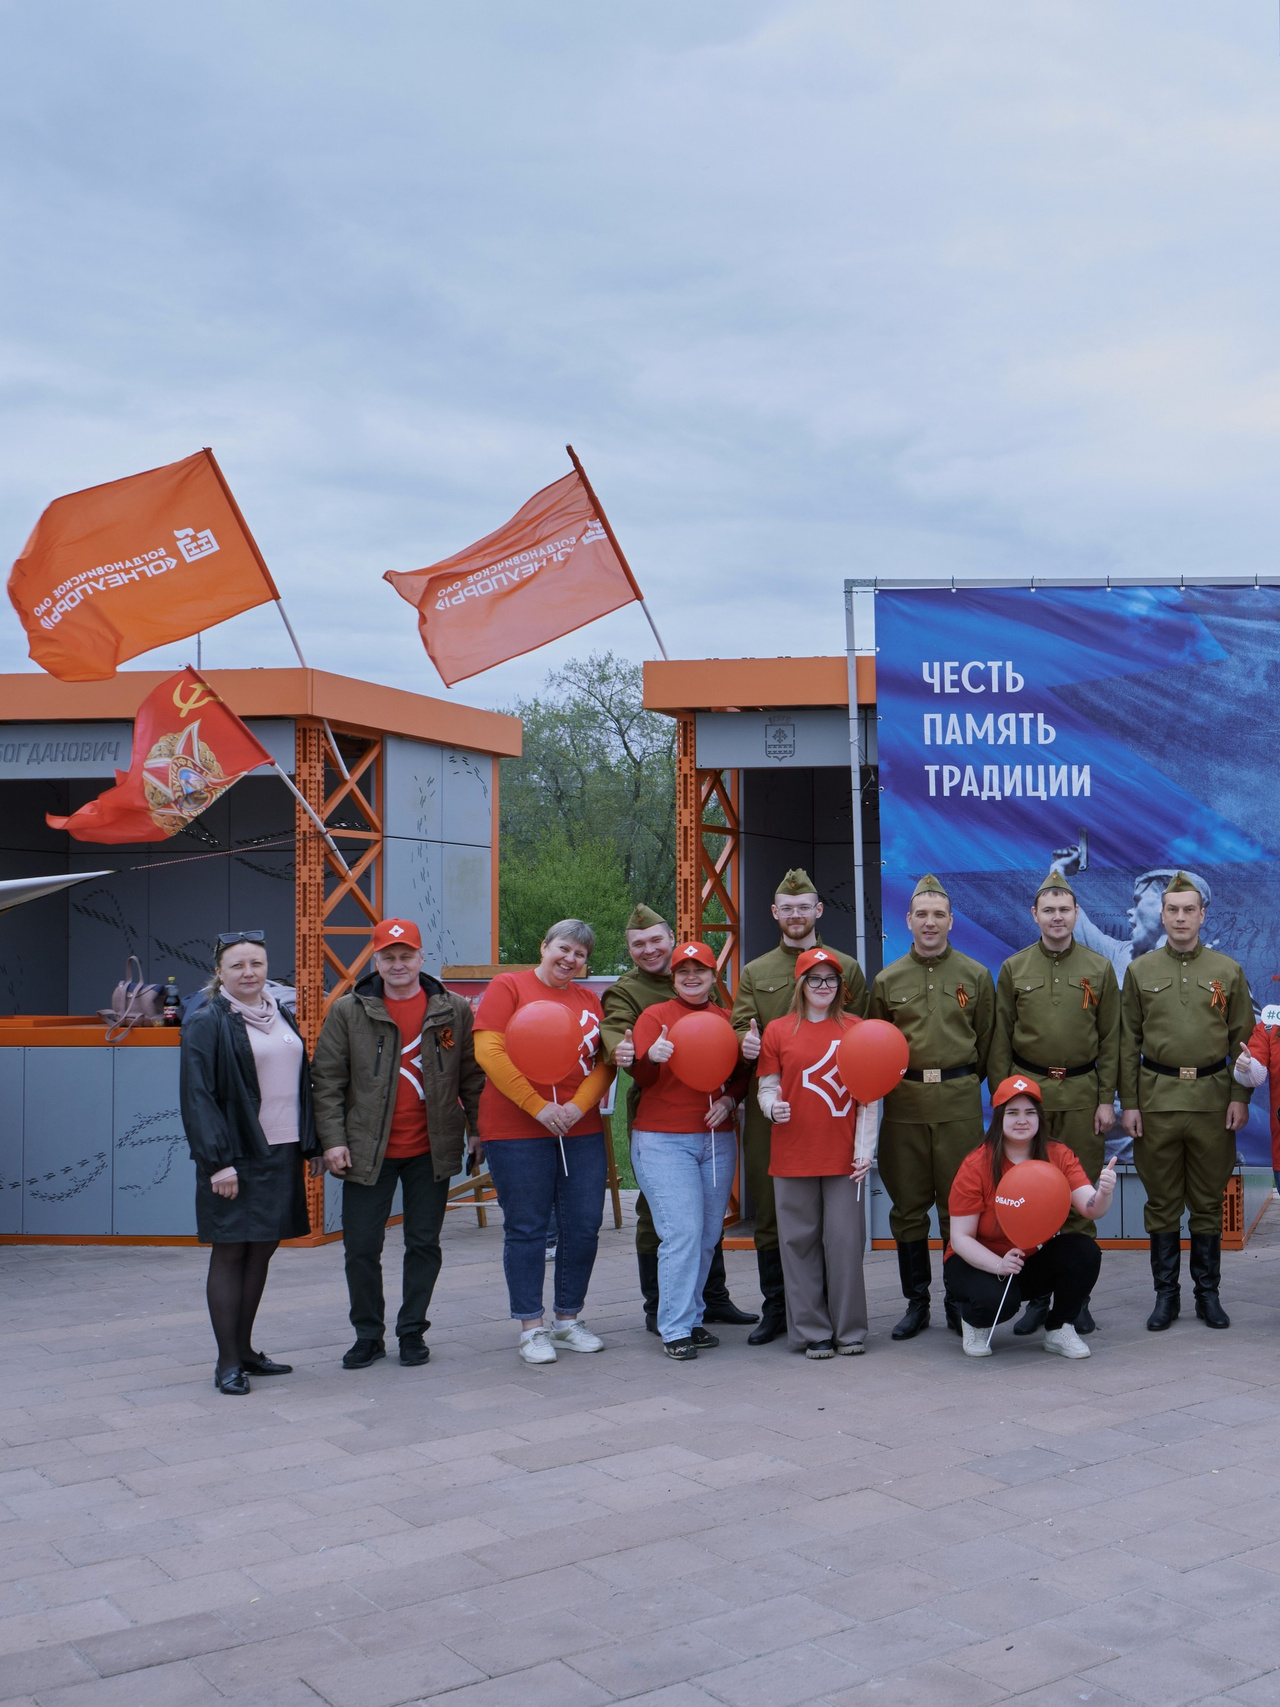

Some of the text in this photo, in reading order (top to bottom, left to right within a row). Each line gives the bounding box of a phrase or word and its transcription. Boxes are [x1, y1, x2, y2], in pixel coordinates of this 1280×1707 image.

[922, 660, 1025, 694] ЧЕСТЬ
[923, 712, 1057, 745] ПАМЯТЬ
[924, 765, 1091, 801] ТРАДИЦИИ
